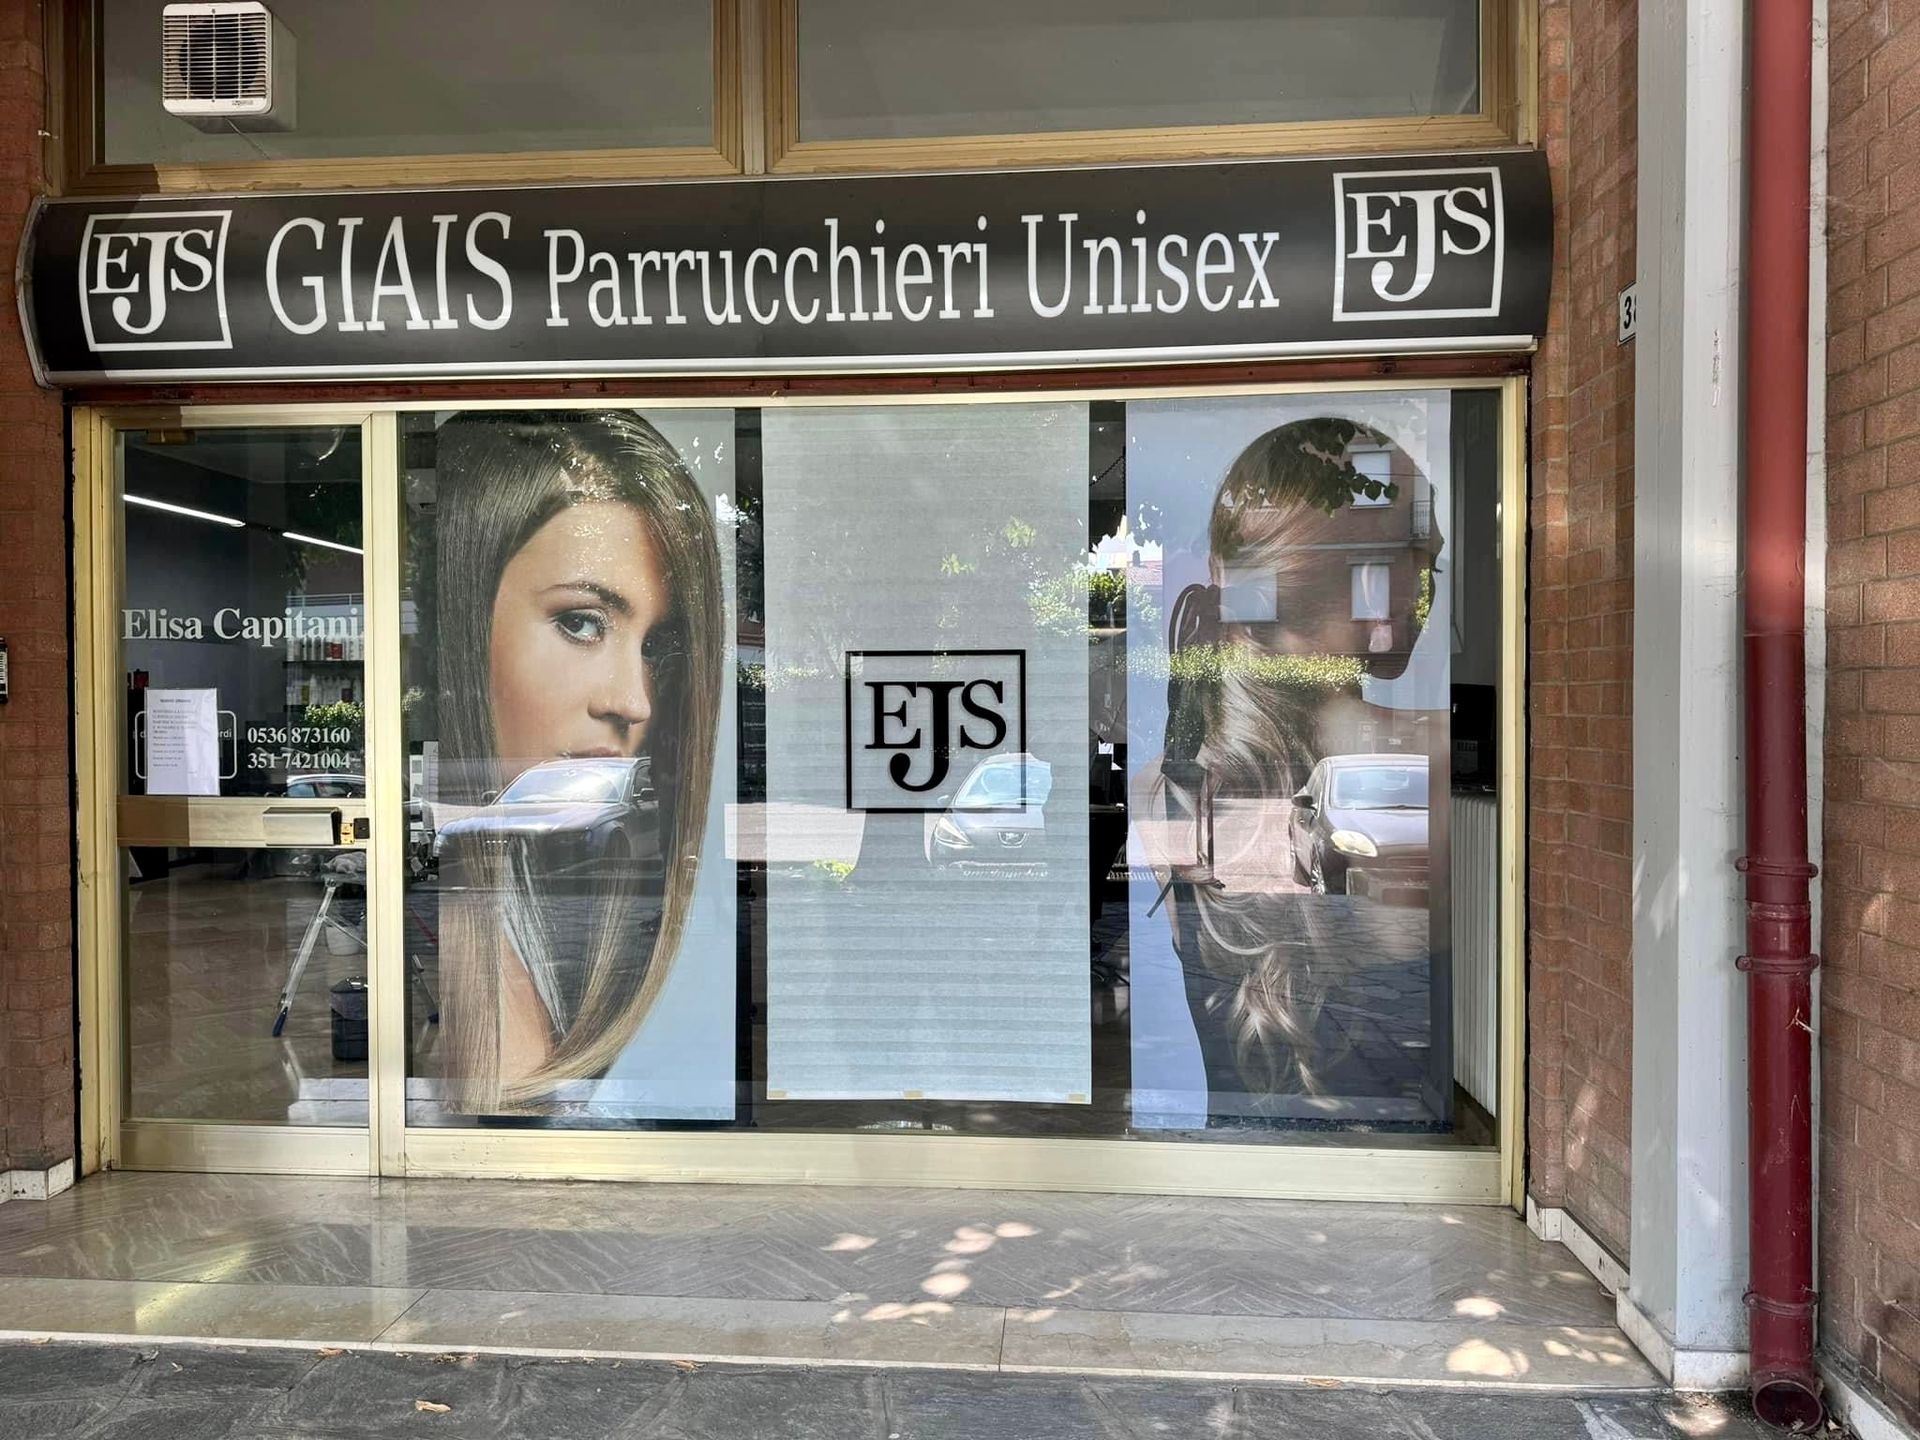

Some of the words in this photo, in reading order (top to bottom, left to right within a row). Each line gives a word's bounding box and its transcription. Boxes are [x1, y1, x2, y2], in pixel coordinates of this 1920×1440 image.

[89, 228, 214, 335] EJS
[265, 211, 514, 336] GIAIS
[543, 215, 995, 328] Parrucchieri
[1021, 209, 1280, 318] Unisex
[1346, 186, 1492, 303] EJS
[1623, 294, 1637, 330] 3
[121, 608, 204, 640] Elisa
[213, 607, 360, 648] Capitani
[247, 727, 287, 744] 0536
[291, 727, 351, 744] 873160
[247, 752, 276, 769] 351
[281, 752, 351, 769] 7421004
[864, 679, 1007, 792] EJS
